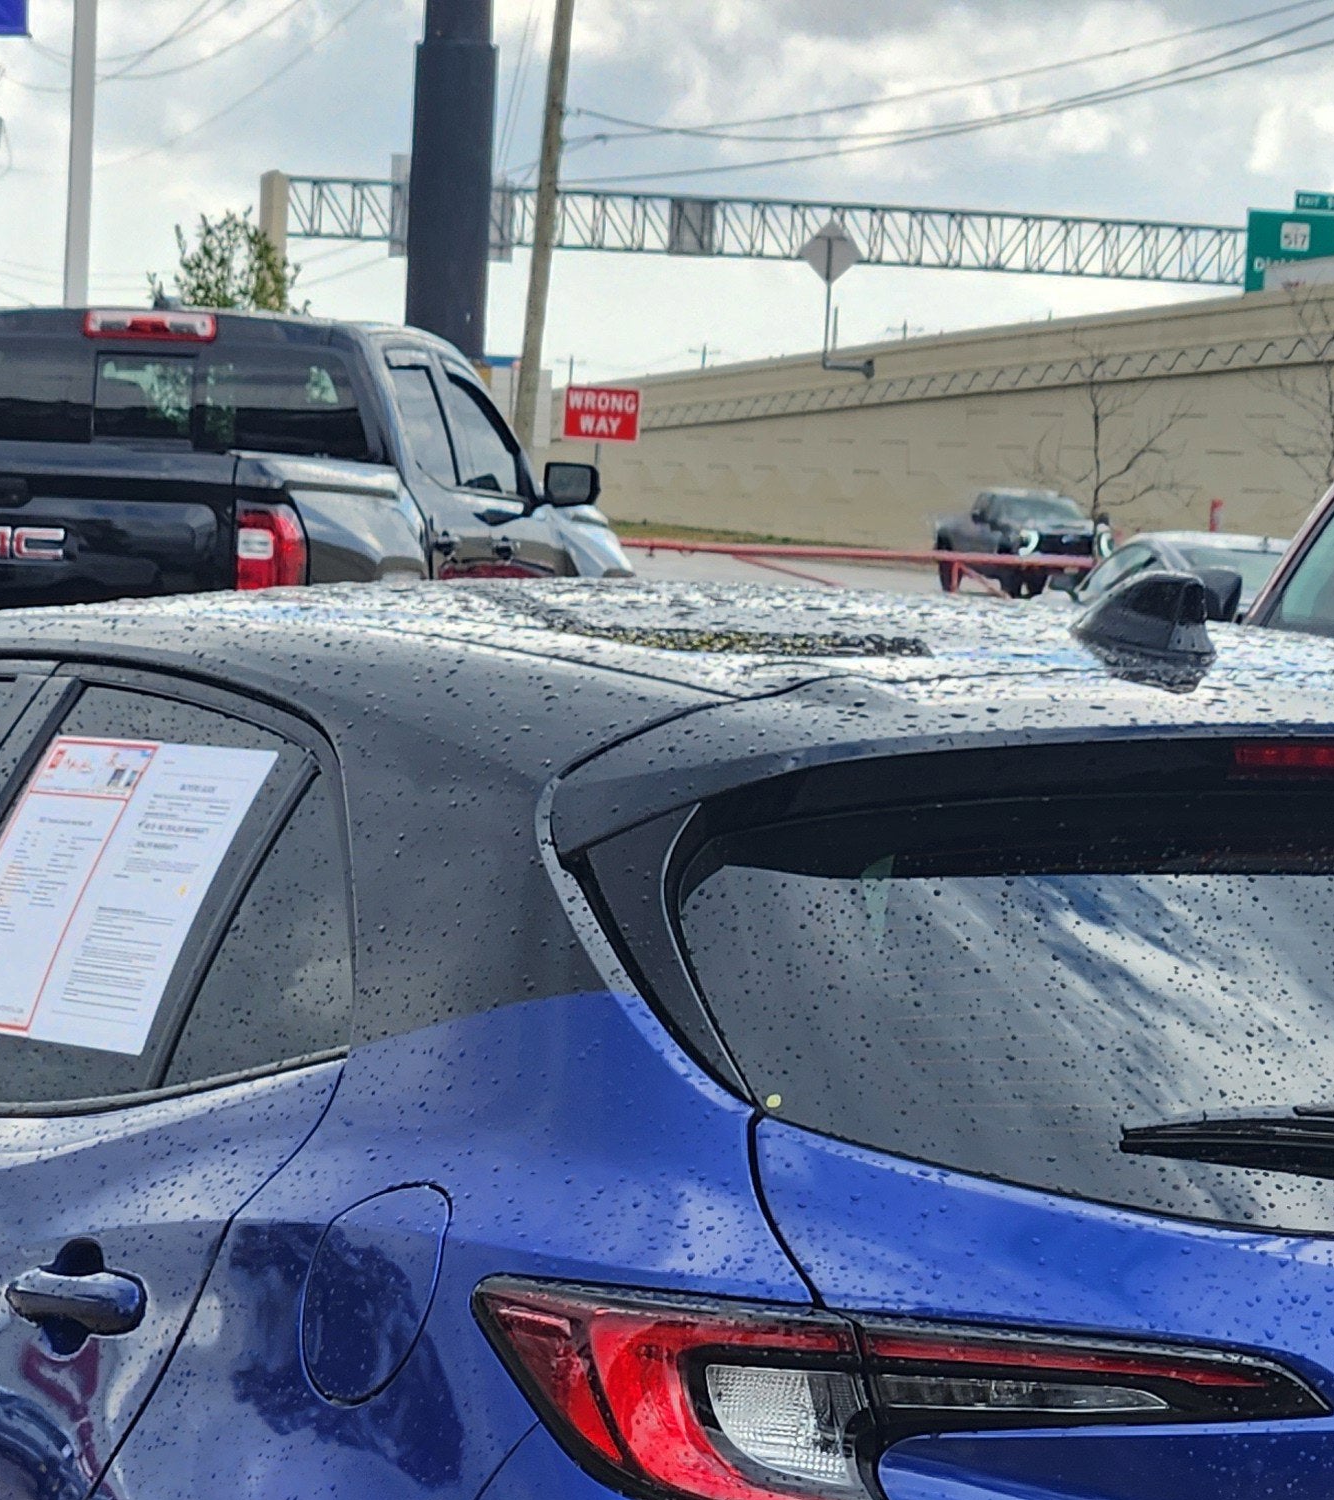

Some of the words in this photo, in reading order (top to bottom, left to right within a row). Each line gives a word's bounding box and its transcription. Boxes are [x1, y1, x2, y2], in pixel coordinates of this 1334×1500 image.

[1283, 233, 1307, 247] 517
[568, 389, 637, 414] WRONG
[579, 413, 622, 436] WAY
